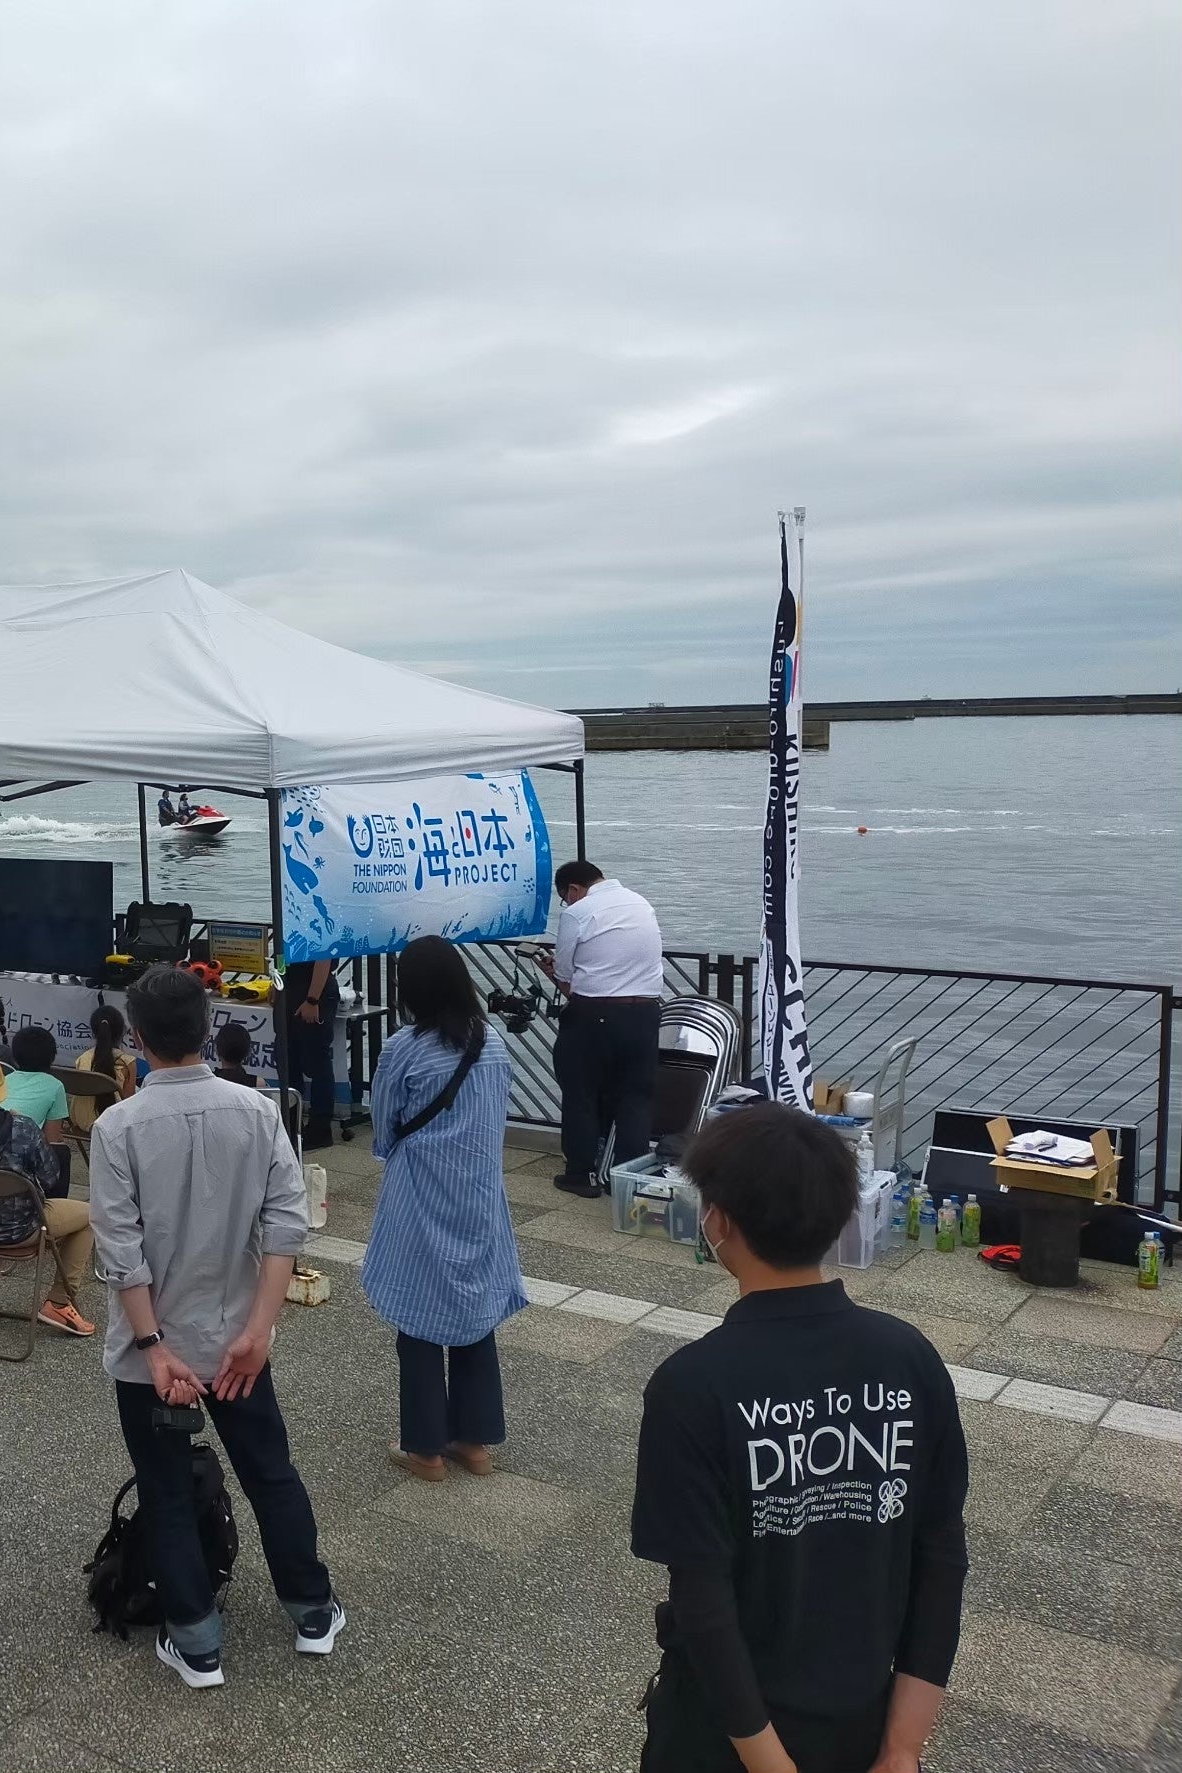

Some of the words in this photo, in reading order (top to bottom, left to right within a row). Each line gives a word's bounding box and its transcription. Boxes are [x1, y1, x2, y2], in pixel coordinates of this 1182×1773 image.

[372, 814, 400, 834] 日本
[378, 837, 405, 858] 財団
[353, 864, 371, 877] THE
[373, 863, 407, 877] NIPPON
[455, 863, 518, 886] PROJECT
[352, 881, 408, 894] FOUNDATION
[737, 1397, 815, 1431] Ways
[823, 1387, 852, 1416] To
[863, 1383, 912, 1412] Use
[747, 1420, 914, 1491] DRONE
[832, 1481, 872, 1491] Inspection
[824, 1491, 872, 1503] Warehousing
[811, 1503, 836, 1512] Rescue
[844, 1500, 872, 1512] Police
[849, 1512, 872, 1523] more
